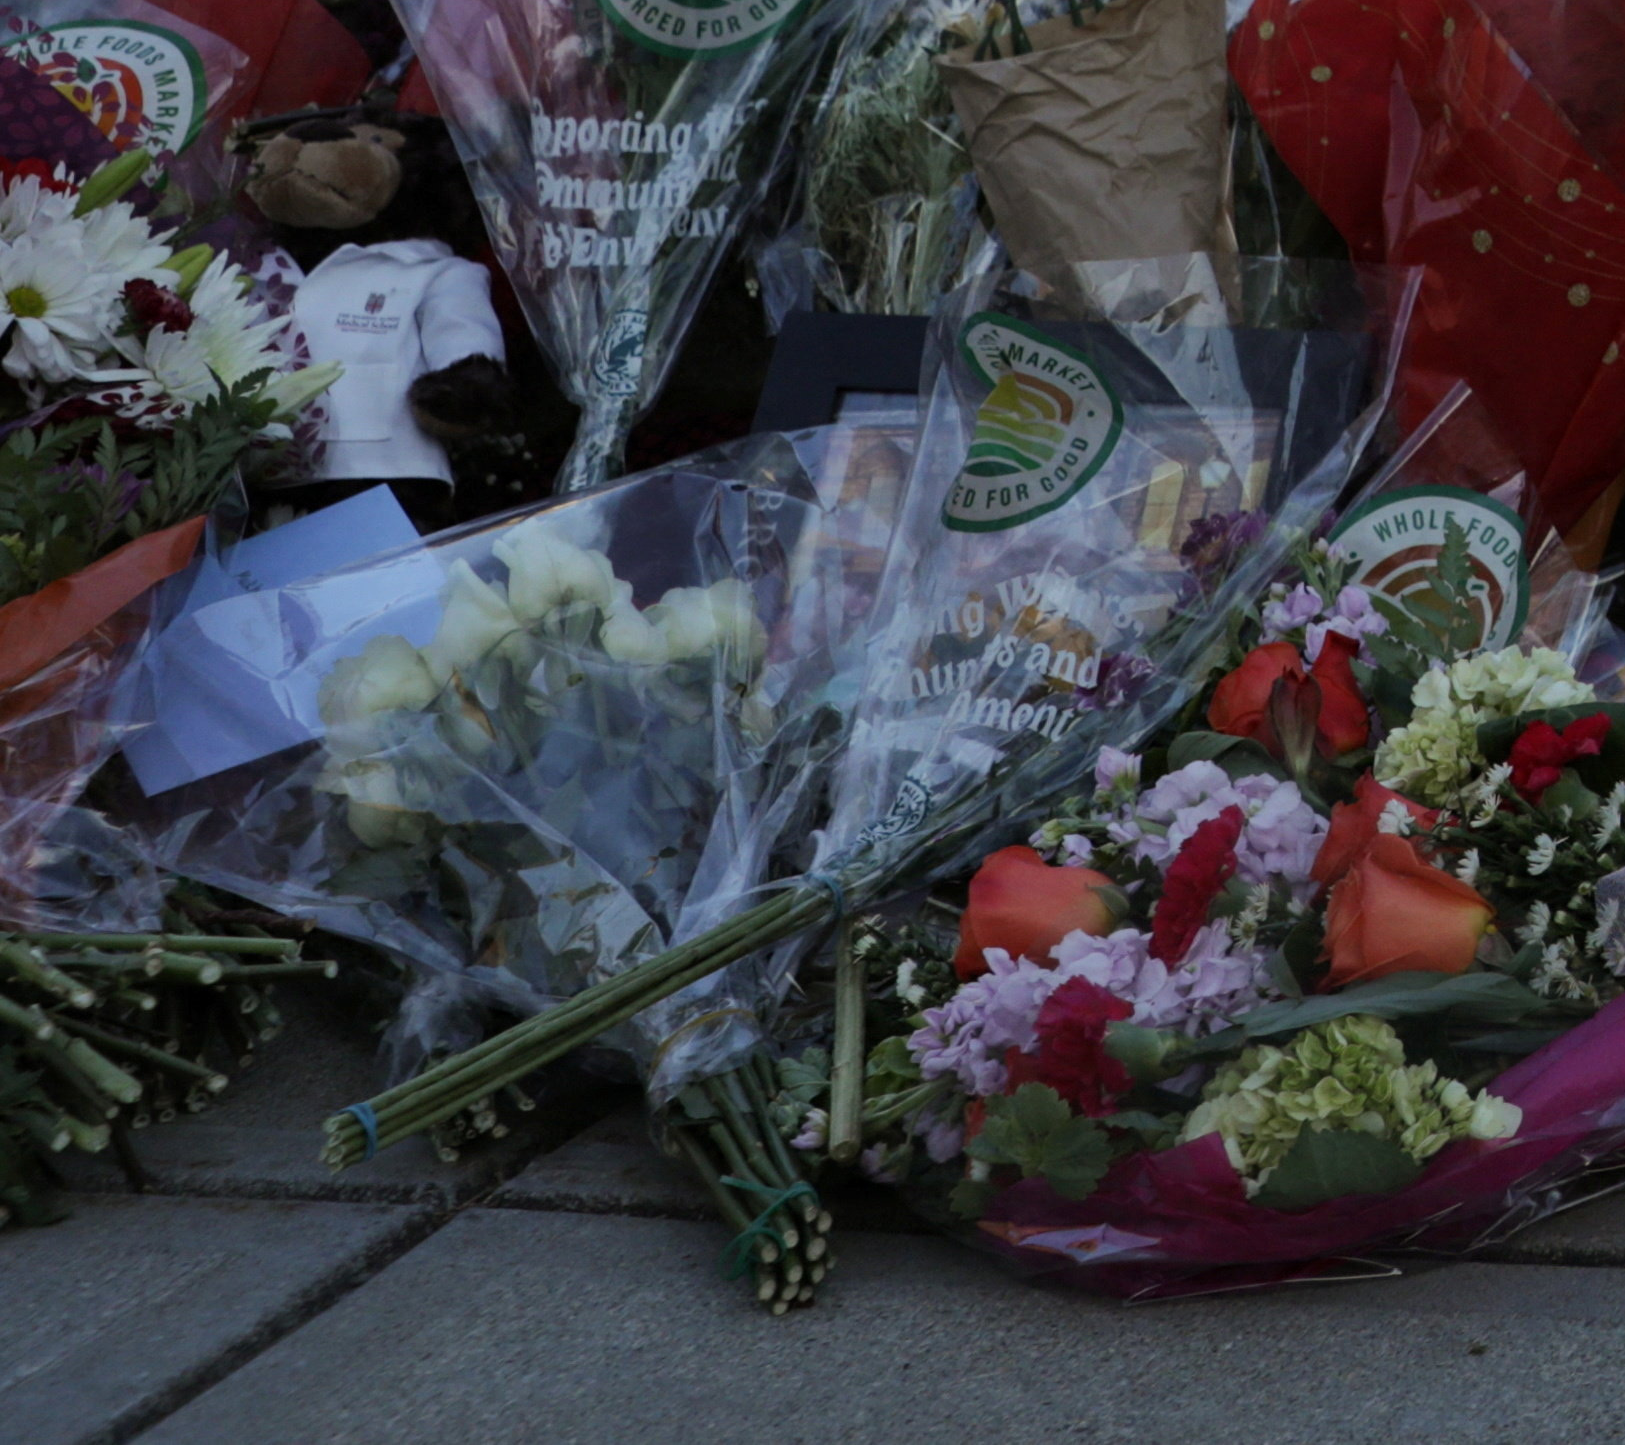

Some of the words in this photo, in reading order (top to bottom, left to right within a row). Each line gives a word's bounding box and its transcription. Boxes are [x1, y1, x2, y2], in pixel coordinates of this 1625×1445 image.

[696, 15, 742, 39] FOR
[97, 36, 165, 66] FOODS
[146, 68, 180, 151] MARKE
[1008, 343, 1095, 392] MARKET
[986, 483, 1029, 509] FOR
[1040, 437, 1088, 492] GOOD
[1372, 509, 1455, 543] WHOLE
[1466, 518, 1518, 568] FOOD
[1025, 641, 1103, 689] and
